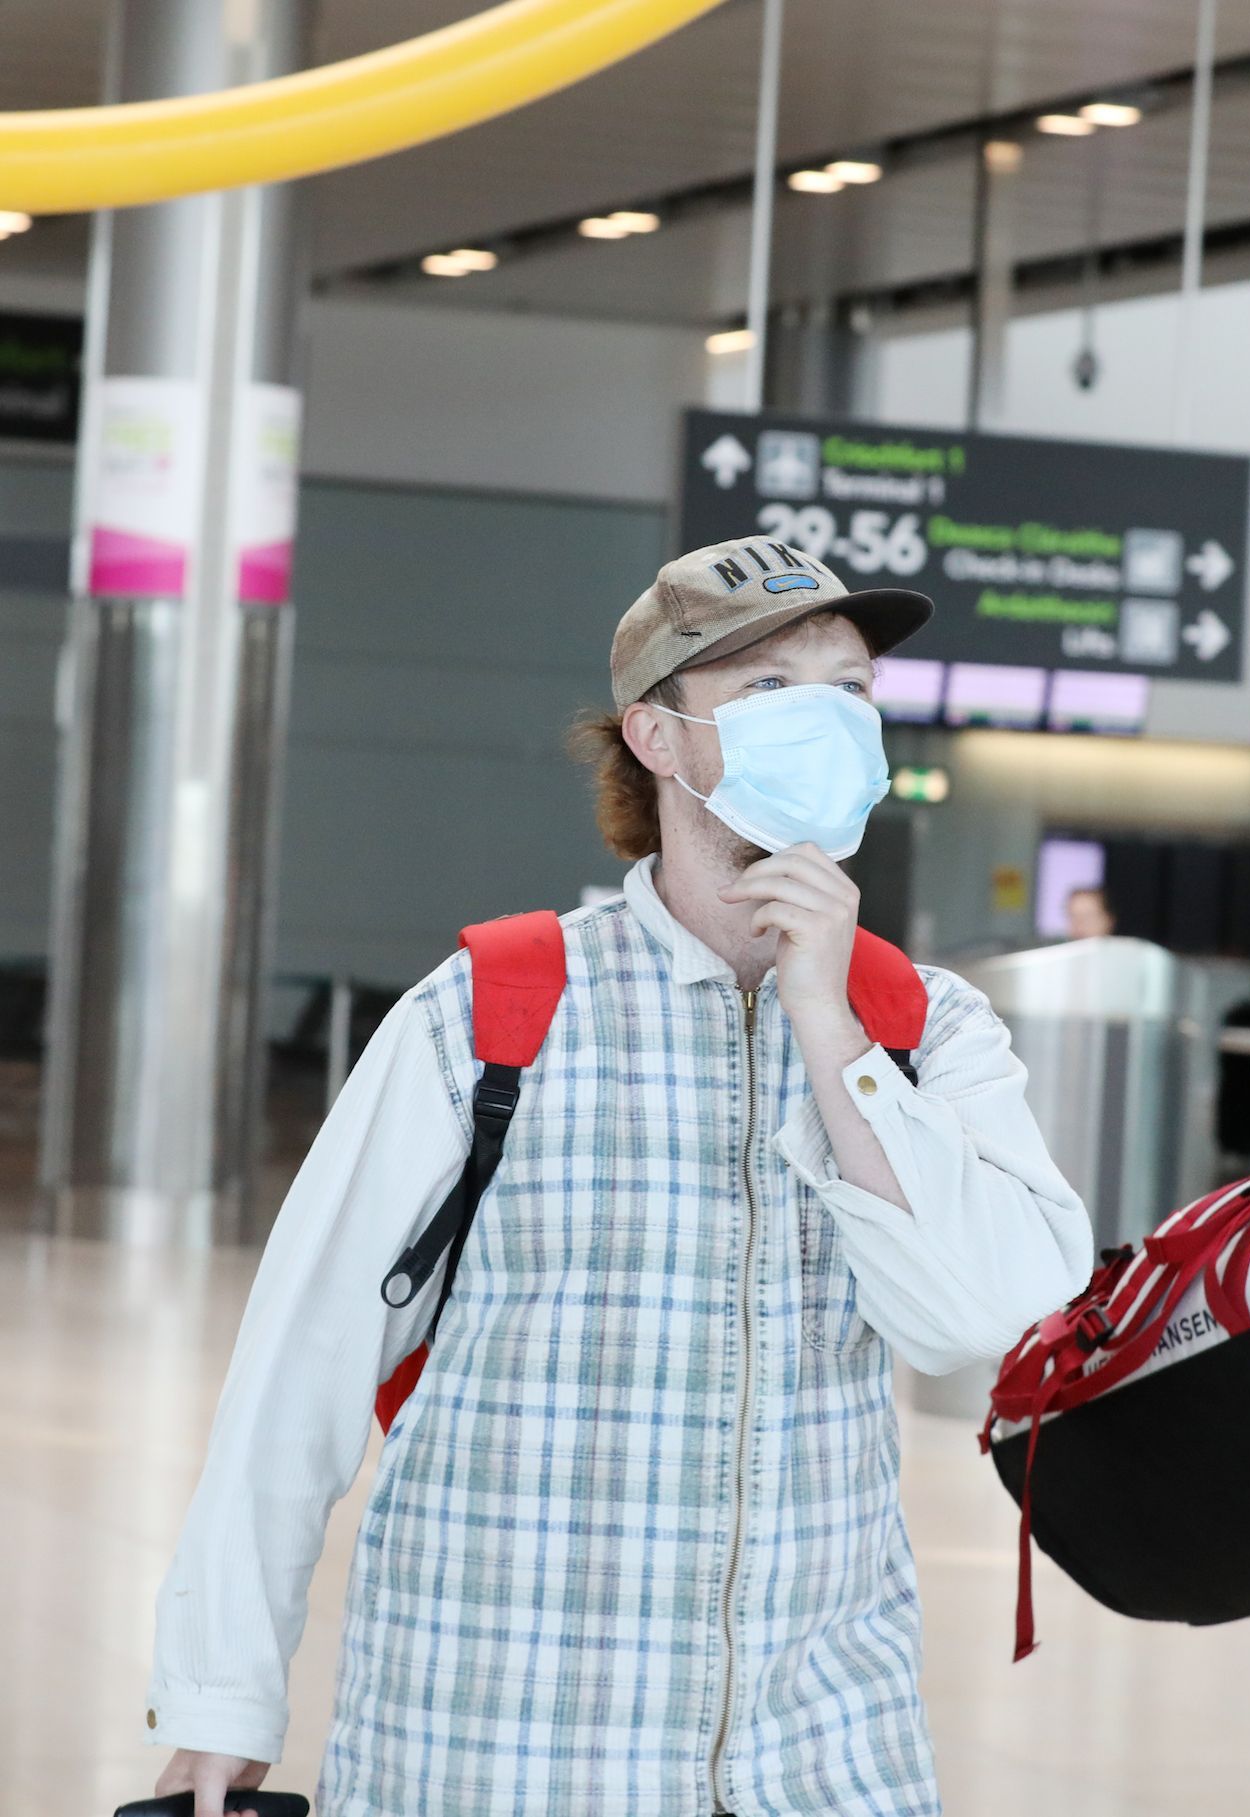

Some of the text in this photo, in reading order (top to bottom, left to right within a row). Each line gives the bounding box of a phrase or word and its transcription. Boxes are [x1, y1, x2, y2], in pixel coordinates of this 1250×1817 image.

[757, 503, 928, 576] 29-56
[712, 542, 824, 590] NIK
[1151, 1309, 1219, 1358] ANSEN
